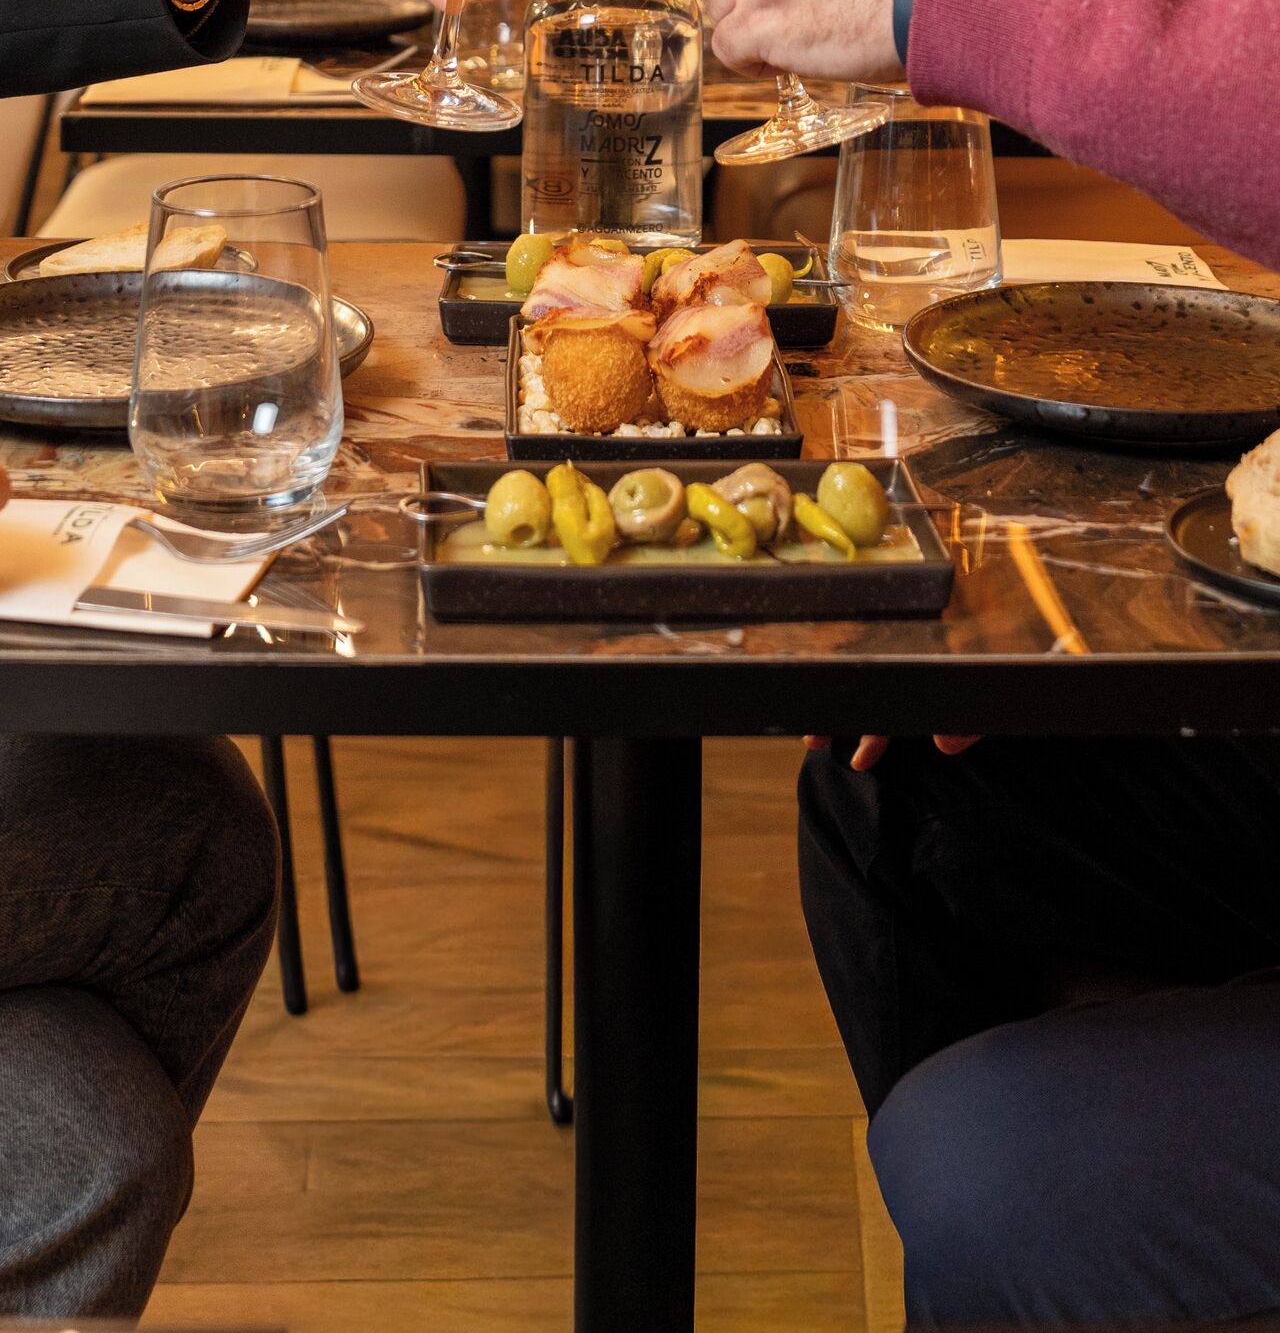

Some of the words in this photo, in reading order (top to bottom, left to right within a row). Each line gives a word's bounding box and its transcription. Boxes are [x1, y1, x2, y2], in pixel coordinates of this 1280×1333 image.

[580, 63, 665, 83] TILDA
[578, 109, 647, 132] SOMOS
[580, 134, 664, 166] MADRIZ
